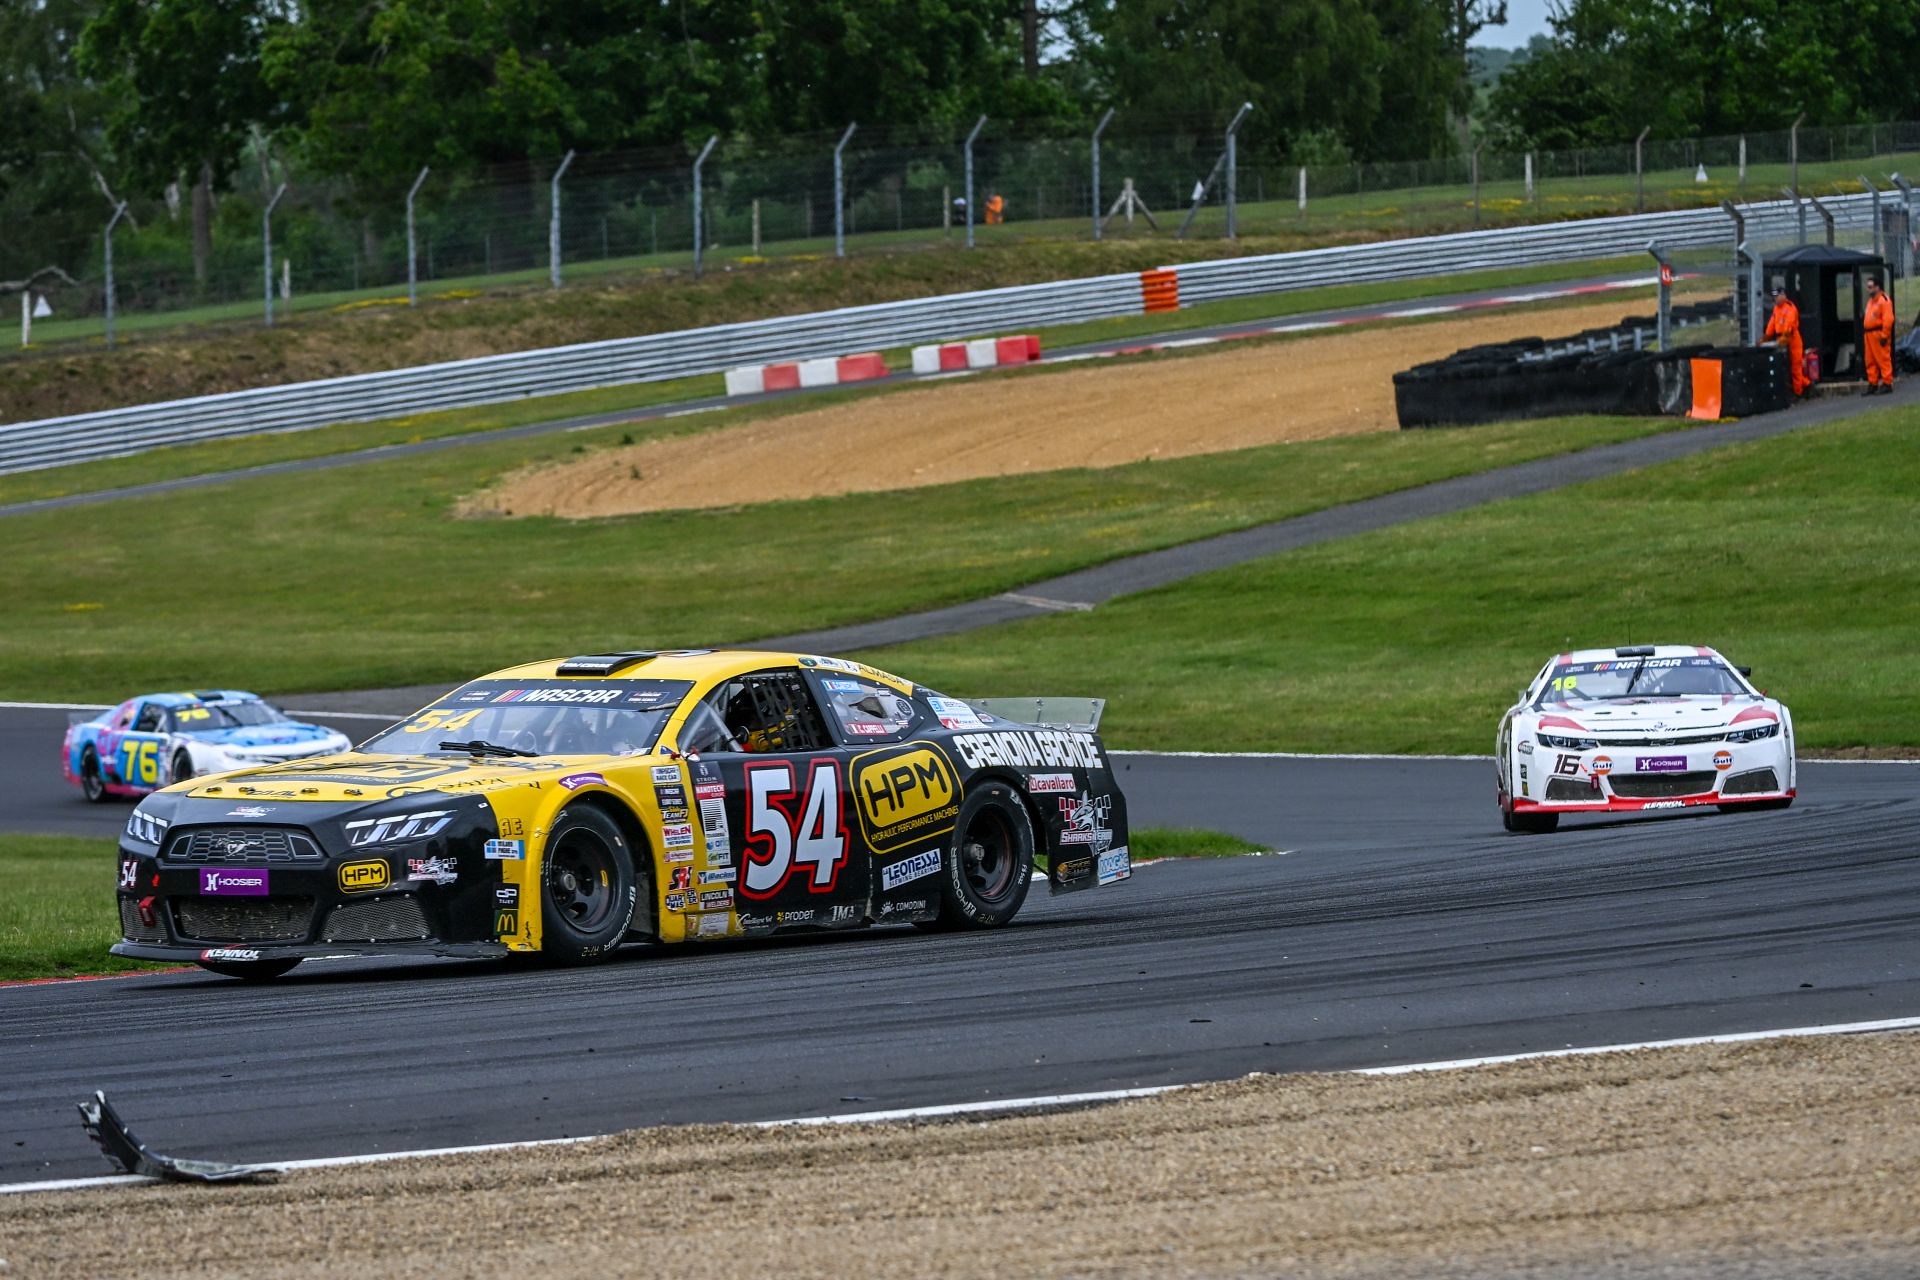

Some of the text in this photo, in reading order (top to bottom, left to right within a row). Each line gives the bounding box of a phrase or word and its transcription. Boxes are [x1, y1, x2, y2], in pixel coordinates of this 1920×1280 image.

[1551, 676, 1577, 692] 16
[519, 689, 622, 703] NASCAR
[175, 708, 210, 722] 76
[404, 708, 484, 733] 54
[123, 740, 158, 784] 76
[1553, 753, 1583, 775] 16
[1592, 761, 1614, 769] Gulf
[1713, 757, 1733, 765] Gulf
[865, 757, 948, 818] HPM
[1037, 778, 1076, 791] cavallaro
[745, 764, 845, 891] 54
[888, 851, 940, 881] LEONESSA
[914, 863, 941, 878] BEARINGS
[120, 861, 138, 887] 54
[344, 867, 383, 883] HPM
[218, 878, 263, 886] HOOSIER
[701, 889, 729, 901] LINCOLN
[205, 948, 260, 959] KENNOL
